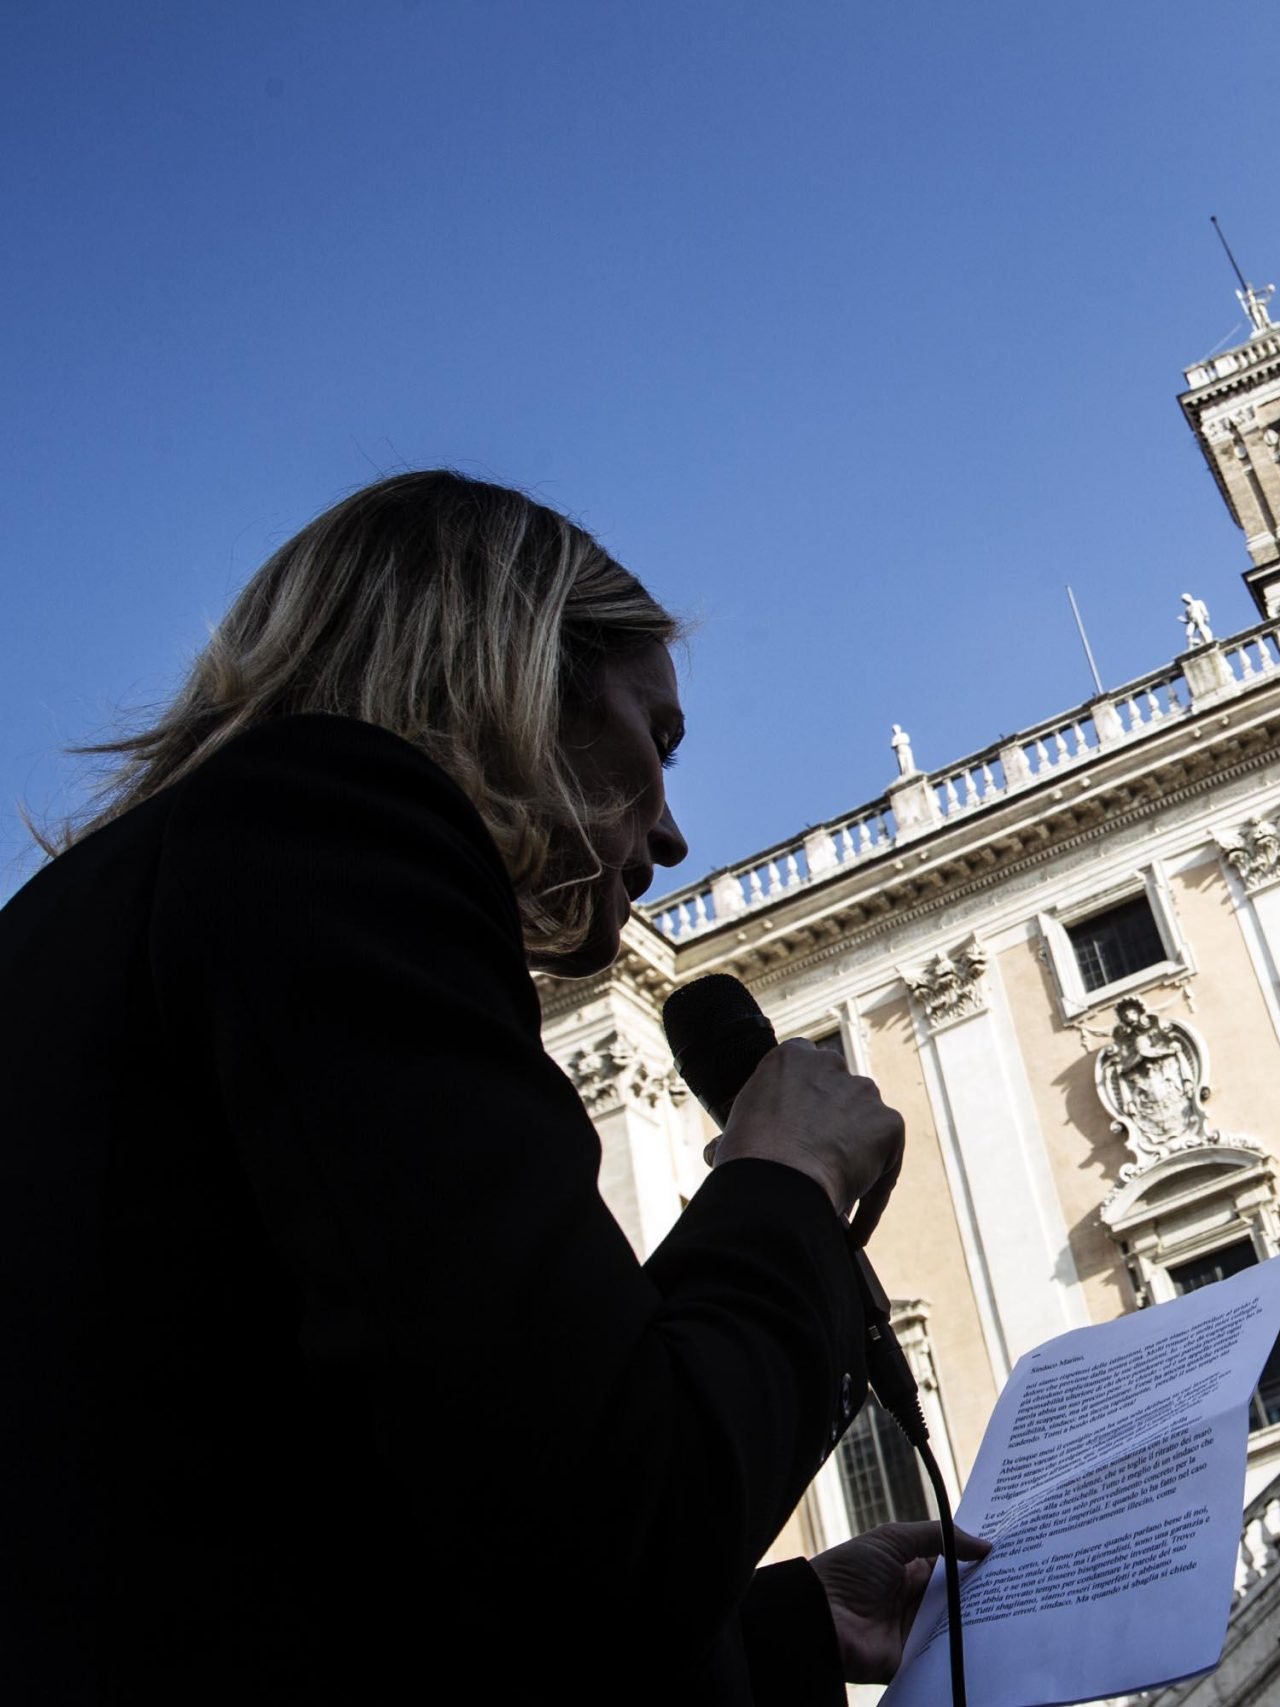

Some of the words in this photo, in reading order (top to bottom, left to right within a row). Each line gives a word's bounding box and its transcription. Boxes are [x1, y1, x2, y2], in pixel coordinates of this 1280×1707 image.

[968, 1592, 981, 1600] per
[982, 1586, 999, 1595] tutti,
[1046, 1570, 1076, 1582] fossero
[1077, 1553, 1128, 1574] bisognerebbe
[1129, 1538, 1168, 1557] inventarli.
[1171, 1531, 1196, 1543] Trovo
[981, 1595, 1003, 1604] abbia
[1004, 1588, 1033, 1599] trovato
[1034, 1583, 1060, 1593] tempo
[1061, 1580, 1074, 1589] per
[1076, 1566, 1121, 1584] condannare
[1131, 1554, 1156, 1569] parole
[1158, 1547, 1170, 1558] del
[1172, 1544, 1187, 1553] suo
[984, 1568, 1014, 1578] sindaco,
[1050, 1552, 1073, 1563] fanno
[1074, 1544, 1101, 1558] piacere
[1103, 1533, 1131, 1549] quando
[1133, 1523, 1162, 1539] parlano
[1163, 1516, 1181, 1527] bene
[1193, 1506, 1208, 1516] noi,
[993, 1573, 1023, 1586] parlano
[1024, 1567, 1044, 1577] male
[1055, 1561, 1069, 1570] noi,
[1090, 1542, 1130, 1562] giornalisti,
[1134, 1535, 1152, 1546] sono
[1154, 1530, 1168, 1539] una
[1170, 1517, 1203, 1536] garanzia
[975, 1605, 994, 1614] Tutti
[995, 1598, 1036, 1610] sbagliamo,
[1040, 1592, 1065, 1601] siamo
[1066, 1584, 1090, 1596] esseri
[1091, 1571, 1130, 1589] imperfetti
[1138, 1559, 1172, 1575] abbiamo
[1012, 1605, 1036, 1615] errori,
[1039, 1600, 1072, 1610] sindaco.
[1075, 1594, 1089, 1602] Ma
[1090, 1585, 1120, 1600] quando
[1130, 1573, 1158, 1587] sbaglia
[1169, 1561, 1197, 1573] chiede
